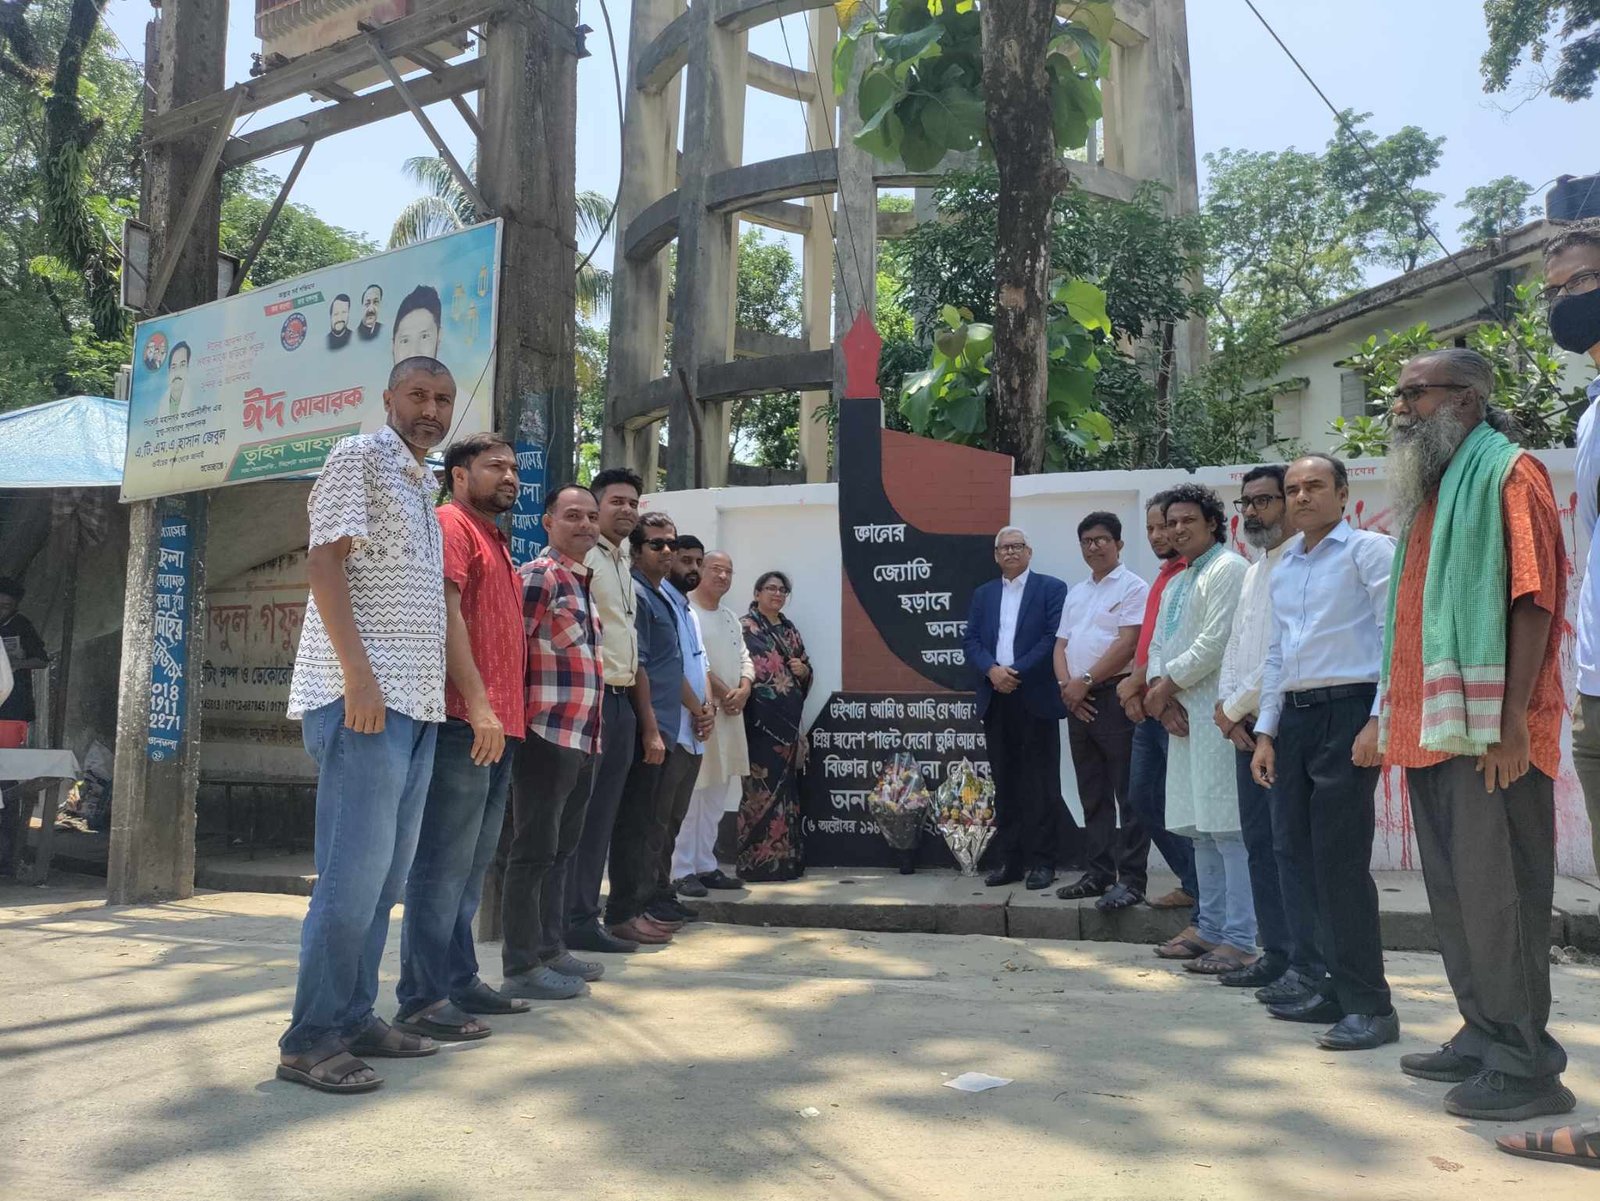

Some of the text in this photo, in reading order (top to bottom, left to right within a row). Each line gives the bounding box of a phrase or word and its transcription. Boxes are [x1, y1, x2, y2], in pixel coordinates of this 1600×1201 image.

[243, 385, 366, 432] ঈদ মোবারক
[177, 434, 201, 450] হাসান
[202, 428, 228, 446] জেবুল
[241, 444, 286, 466] তুহিন
[853, 523, 907, 543] জ্ঞানের
[158, 547, 185, 571] চুলা
[873, 557, 933, 583] জ্যোতি
[898, 592, 953, 614] ছড়াবে
[154, 610, 183, 643] মিহির
[260, 597, 308, 653] গফু
[920, 648, 966, 666] অনন্ত
[152, 682, 180, 702] 018
[150, 695, 177, 716] 1911
[830, 697, 866, 722] ওইখানে
[870, 697, 904, 719] আমিও
[907, 698, 936, 721] আছি
[149, 713, 181, 731] 2271
[833, 731, 866, 750] স্বদেশ
[902, 730, 933, 750] দেবো
[935, 728, 957, 754] তুমি
[957, 732, 977, 750] আর
[823, 754, 869, 778] বিজ্ঞান
[818, 817, 857, 834] অক্টোবর
